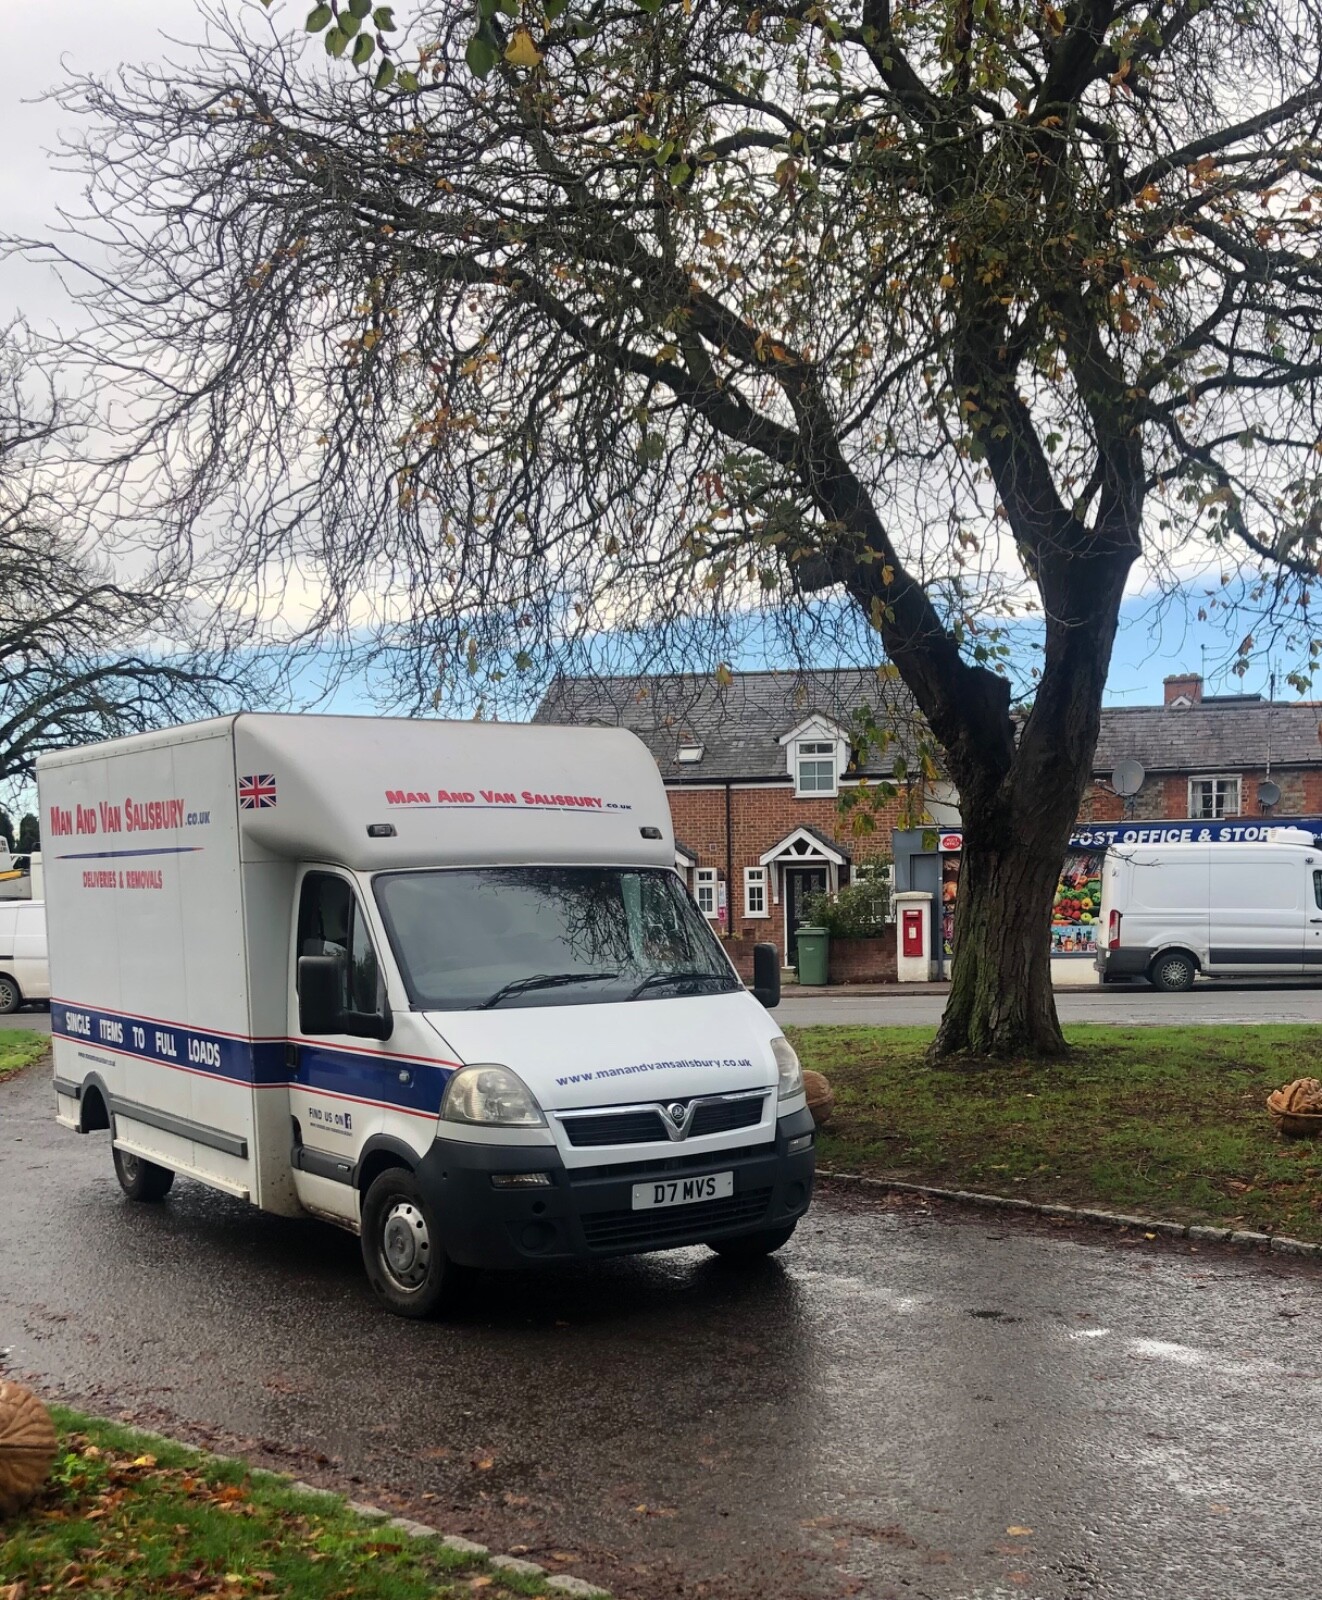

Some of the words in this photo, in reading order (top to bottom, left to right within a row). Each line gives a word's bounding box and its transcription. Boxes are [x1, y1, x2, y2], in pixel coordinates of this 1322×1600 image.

[385, 790, 431, 804] MAN
[438, 790, 475, 803] AND
[479, 790, 517, 804] VAN
[50, 806, 73, 836] MAN
[76, 804, 97, 835] AND
[99, 801, 122, 833] VAN
[1068, 830, 1118, 846] POST
[1123, 828, 1192, 844] OFFICE
[1198, 828, 1212, 842] &
[83, 870, 117, 888] DELIVERIES
[119, 871, 124, 888] &
[126, 870, 163, 889] REMOVALS
[65, 1011, 91, 1035] SINGLE
[99, 1019, 123, 1044] ITEMS
[132, 1026, 145, 1049] TO
[155, 1031, 177, 1057] FULL
[188, 1038, 221, 1067] LOADS
[555, 1059, 752, 1086] www.manandvansalisbury.co.uk
[309, 1107, 322, 1120] FIND
[324, 1111, 333, 1123] US
[335, 1113, 344, 1125] ON
[653, 1183, 678, 1204] D7
[683, 1177, 716, 1201] MVS
